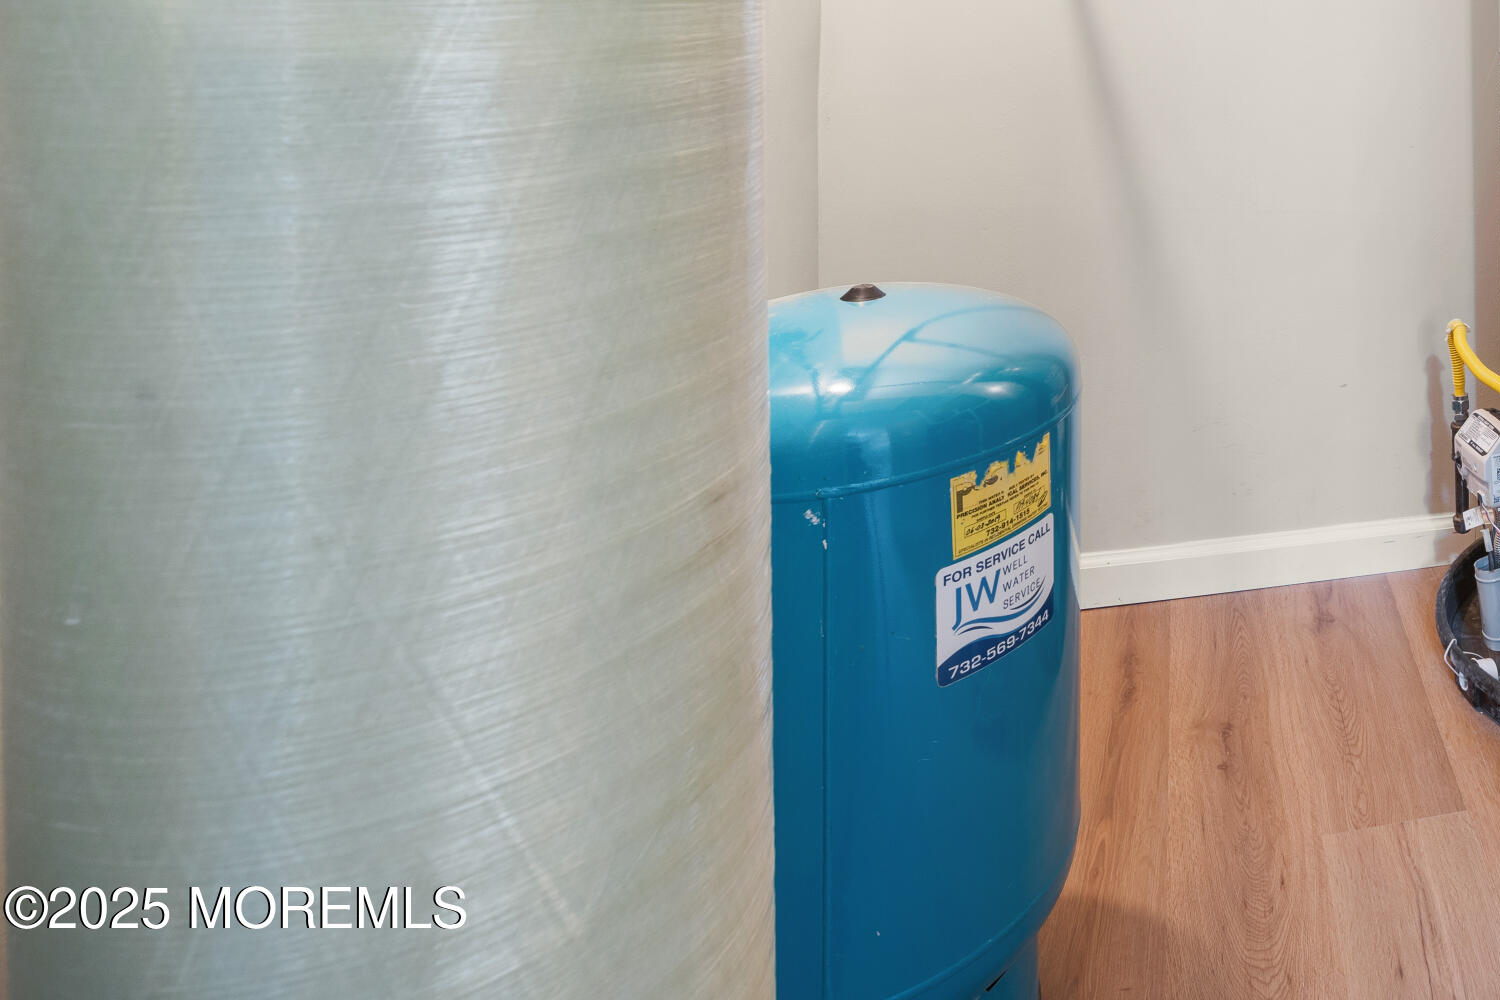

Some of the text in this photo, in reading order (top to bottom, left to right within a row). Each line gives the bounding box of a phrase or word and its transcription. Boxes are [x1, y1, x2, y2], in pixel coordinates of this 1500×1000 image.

[943, 522, 1051, 587] FOR SERVICE CALL
[1002, 554, 1028, 576] WELL
[952, 567, 1001, 631] JW
[1002, 565, 1035, 593] WATER
[1002, 577, 1040, 610] SERVICE
[948, 609, 1049, 679] 732-569-7344
